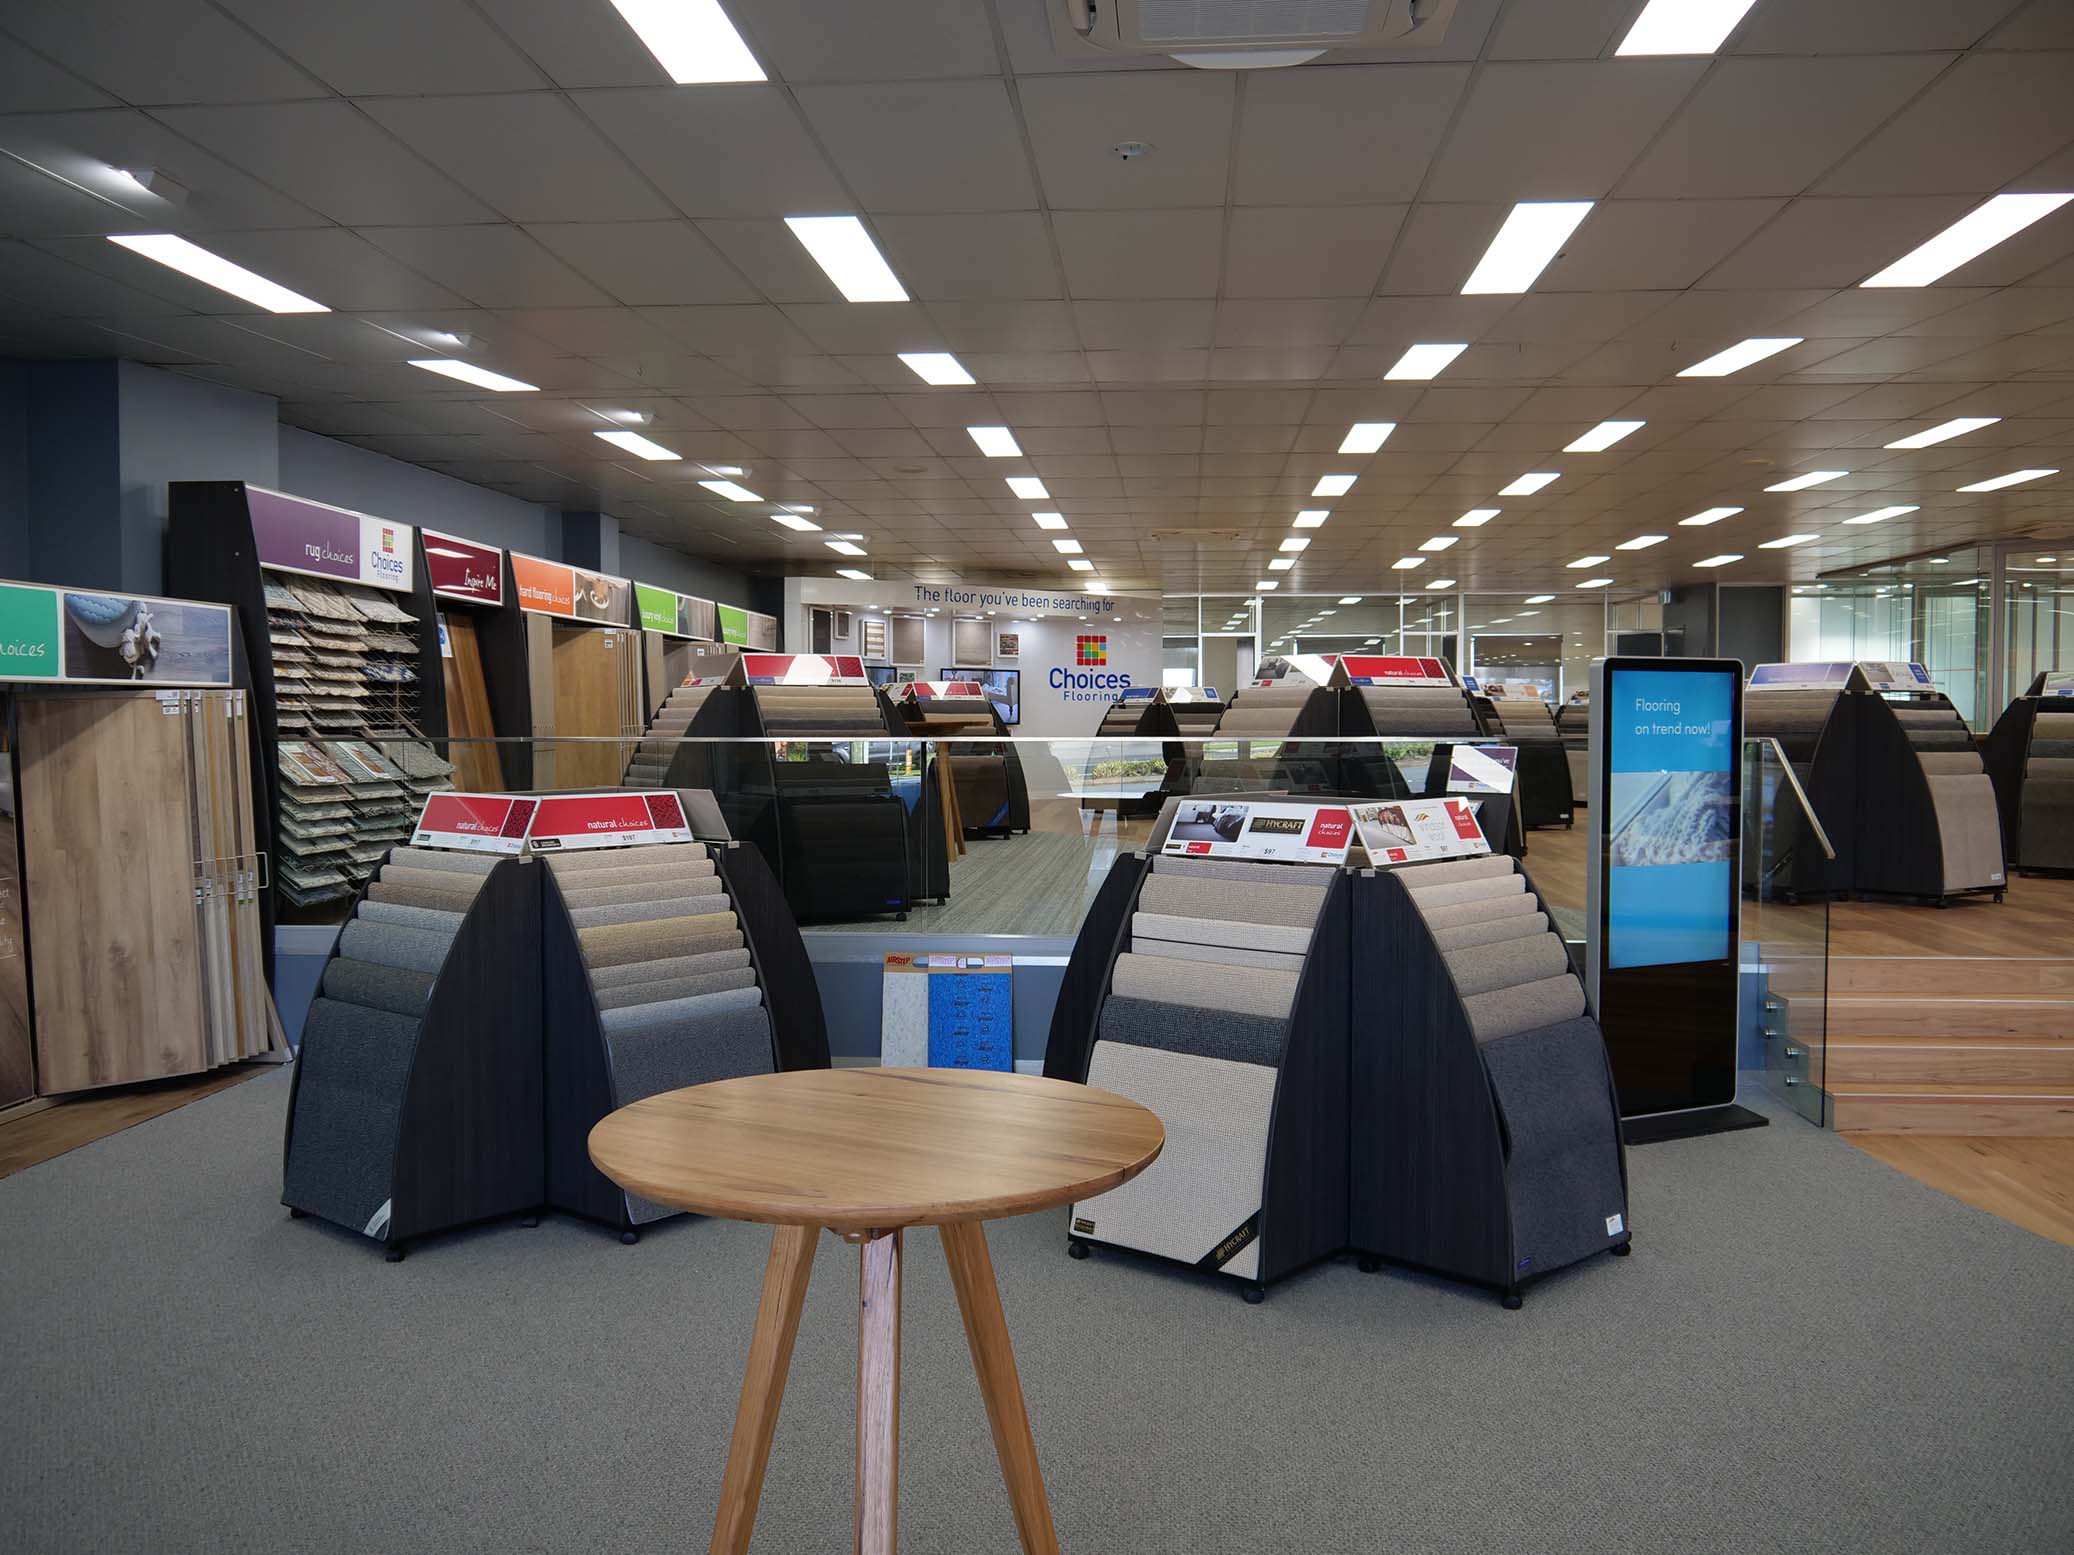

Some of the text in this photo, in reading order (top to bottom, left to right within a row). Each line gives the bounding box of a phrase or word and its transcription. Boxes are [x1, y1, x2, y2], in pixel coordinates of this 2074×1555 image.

[305, 540, 353, 565] rug choices
[371, 551, 403, 573] Choices
[485, 574, 497, 590] Me
[914, 585, 1115, 615] The floor you've been searching for
[1049, 667, 1131, 689] Choices
[1635, 698, 1681, 715] Flooring
[1635, 722, 1711, 735] on trend now!
[456, 822, 477, 831] natural
[587, 817, 649, 830] natural choices
[1265, 819, 1305, 831] HYCRAFT
[1320, 822, 1344, 831] natural
